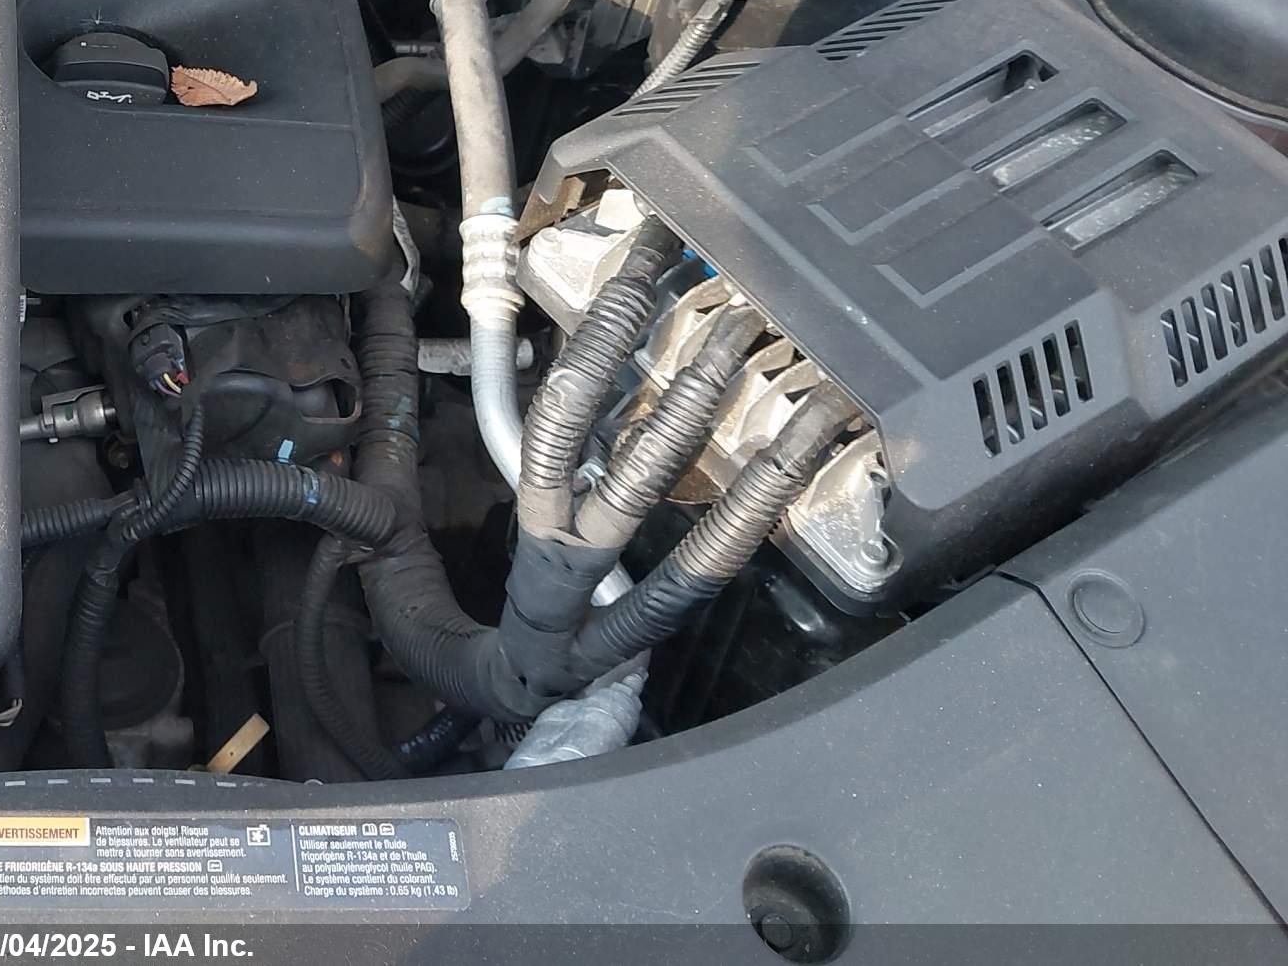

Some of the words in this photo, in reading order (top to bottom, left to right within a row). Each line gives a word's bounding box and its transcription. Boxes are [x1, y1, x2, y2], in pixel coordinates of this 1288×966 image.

[96, 826, 132, 835] Attention
[151, 827, 178, 836] doigts!
[181, 827, 208, 836] Risque
[299, 826, 357, 835] CLIMATISEUR
[109, 837, 150, 846] blessures.
[165, 837, 207, 846] ventilateur
[210, 838, 228, 847] peut
[300, 840, 327, 849] Utiliser
[330, 840, 372, 849] seulement
[384, 840, 407, 849] fluide
[97, 849, 123, 857] mettre
[133, 849, 162, 857] tourner
[187, 848, 246, 857] avertissement.
[347, 852, 377, 861] R-134a
[402, 852, 427, 861] l'huile
[66, 862, 98, 872] R-134a
[100, 862, 124, 872] SOUS
[126, 862, 155, 872] HAUTE
[158, 862, 201, 872] PRESSION
[391, 863, 412, 873] (huile
[415, 863, 437, 873] PAG).
[30, 874, 64, 884] système
[67, 874, 82, 883] doit
[85, 874, 100, 884] être
[103, 873, 137, 883] effectué
[139, 875, 153, 885] par
[168, 875, 208, 885] personnel
[211, 874, 240, 885] qualifié
[243, 874, 288, 883] seulement.
[316, 874, 350, 885] système
[352, 874, 385, 883] contient
[387, 874, 397, 883] du
[400, 874, 435, 883] colorant.
[33, 886, 77, 895] d'entretien
[80, 886, 126, 895] incorrectes
[128, 887, 161, 897] peuvent
[164, 887, 192, 895] causer
[194, 887, 208, 895] des
[211, 887, 252, 895] blessures.
[304, 886, 334, 898] Charge
[349, 885, 383, 897] système
